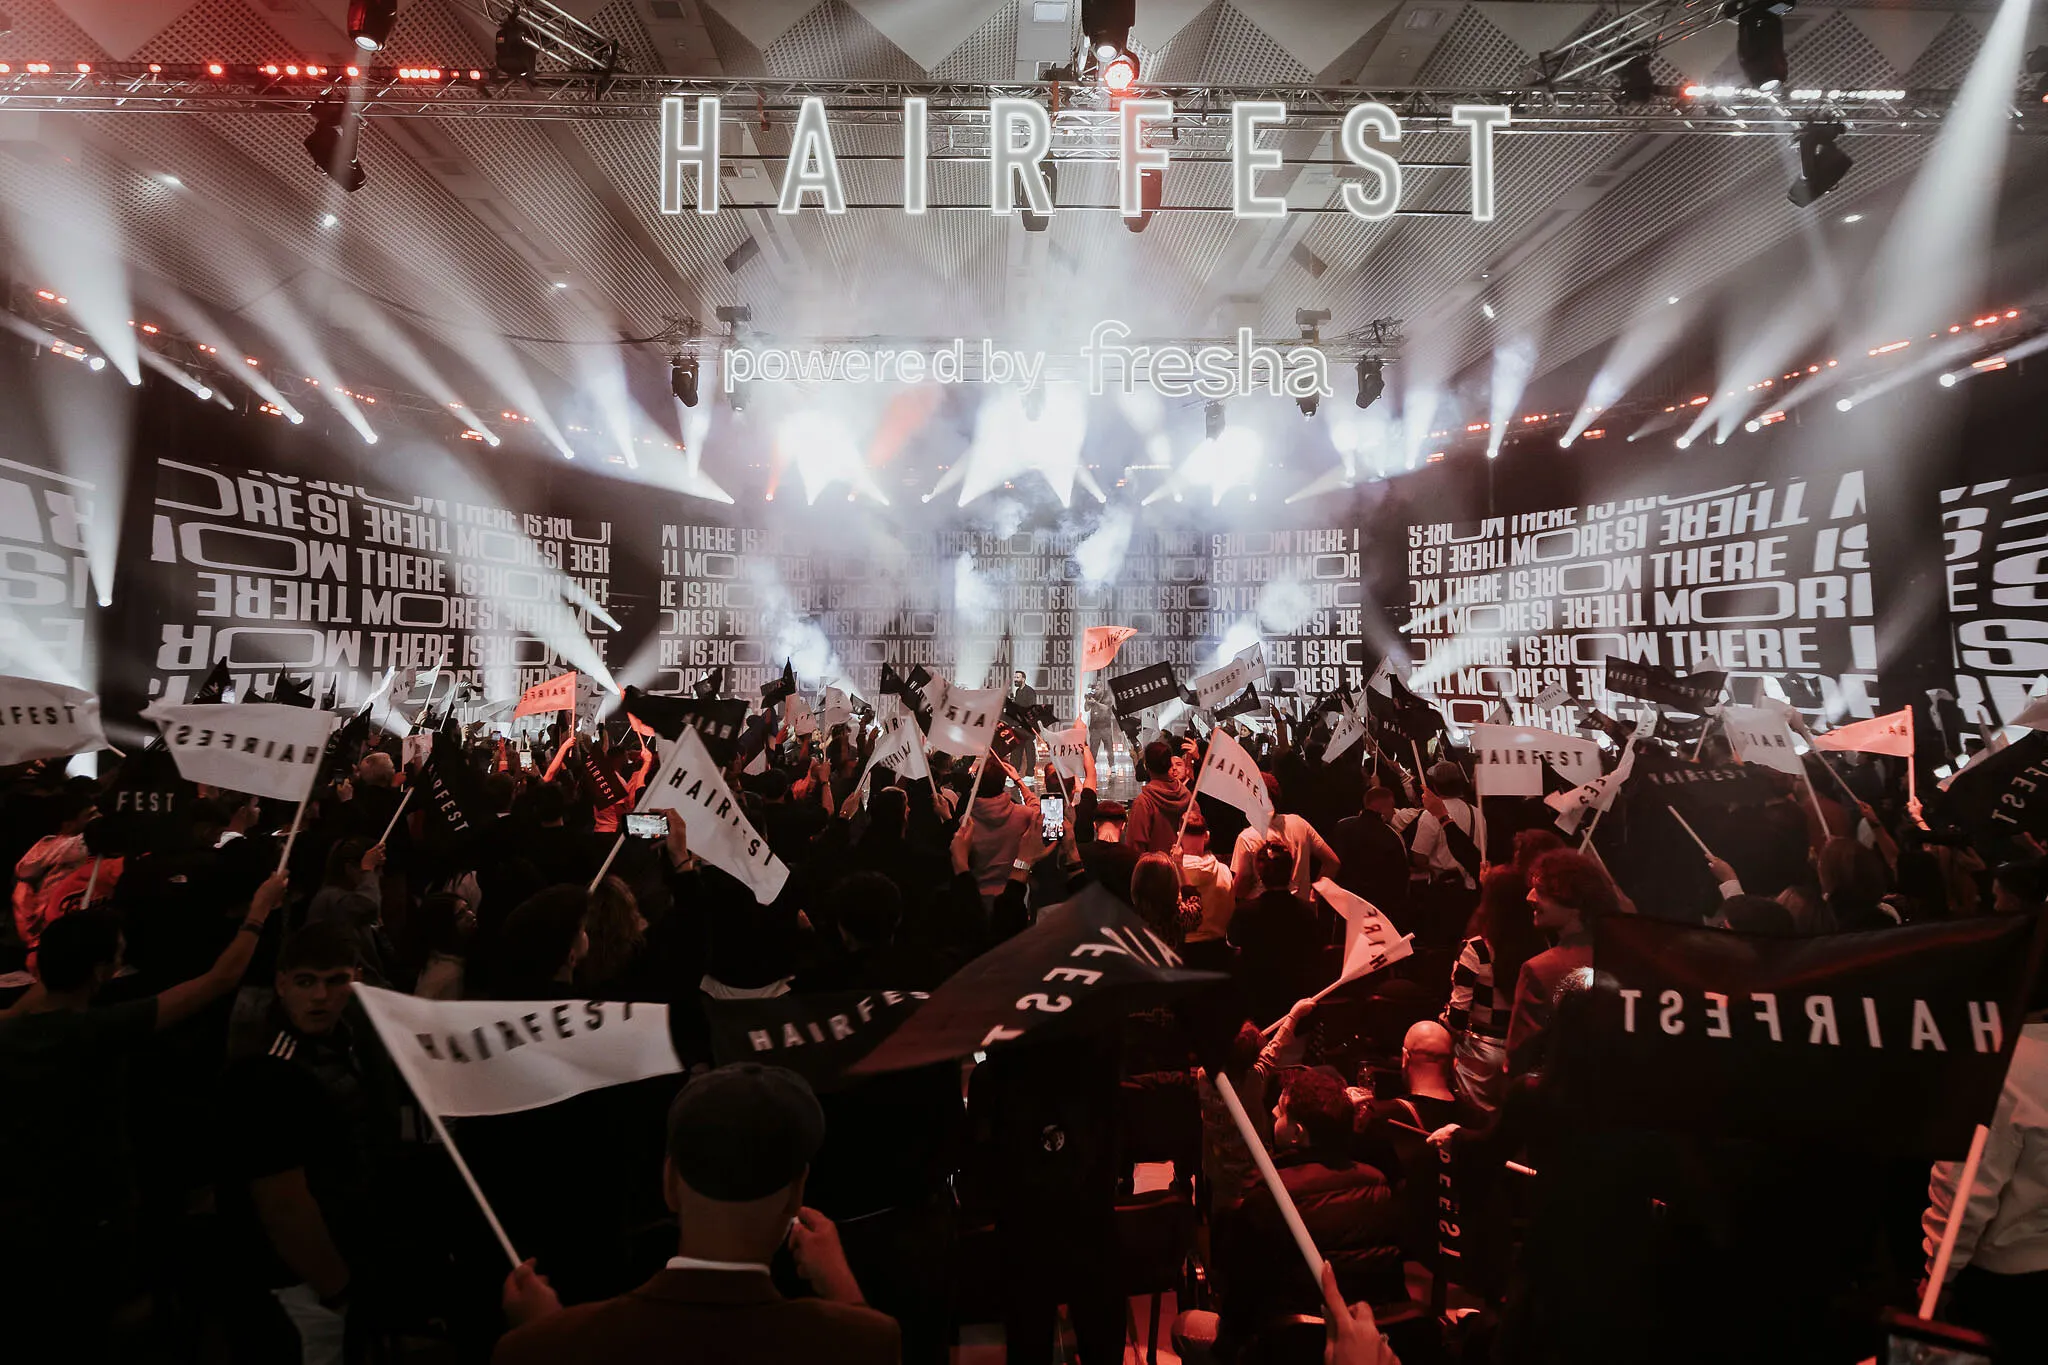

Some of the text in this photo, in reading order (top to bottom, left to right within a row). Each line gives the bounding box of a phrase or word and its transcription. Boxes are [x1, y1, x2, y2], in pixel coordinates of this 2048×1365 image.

[658, 95, 1513, 222] HAIRFEST
[722, 319, 1333, 398] powered by fresha
[362, 504, 451, 554] THERE
[684, 525, 736, 552] THERE
[1659, 481, 1809, 546] THERE
[356, 547, 446, 592] THERE
[1444, 572, 1502, 606] THERE
[1650, 535, 1789, 588] THERE
[1449, 538, 1507, 573] THERE
[1511, 520, 1613, 566] MORE
[196, 571, 353, 623] THERE
[361, 588, 477, 631] MORE
[1562, 593, 1648, 635] THERE
[370, 631, 455, 668] THERE
[1666, 627, 1821, 669] THERE
[1475, 748, 1584, 767] HAIRFEST
[116, 790, 176, 813] FEST
[415, 1000, 634, 1064] HAIRFEST
